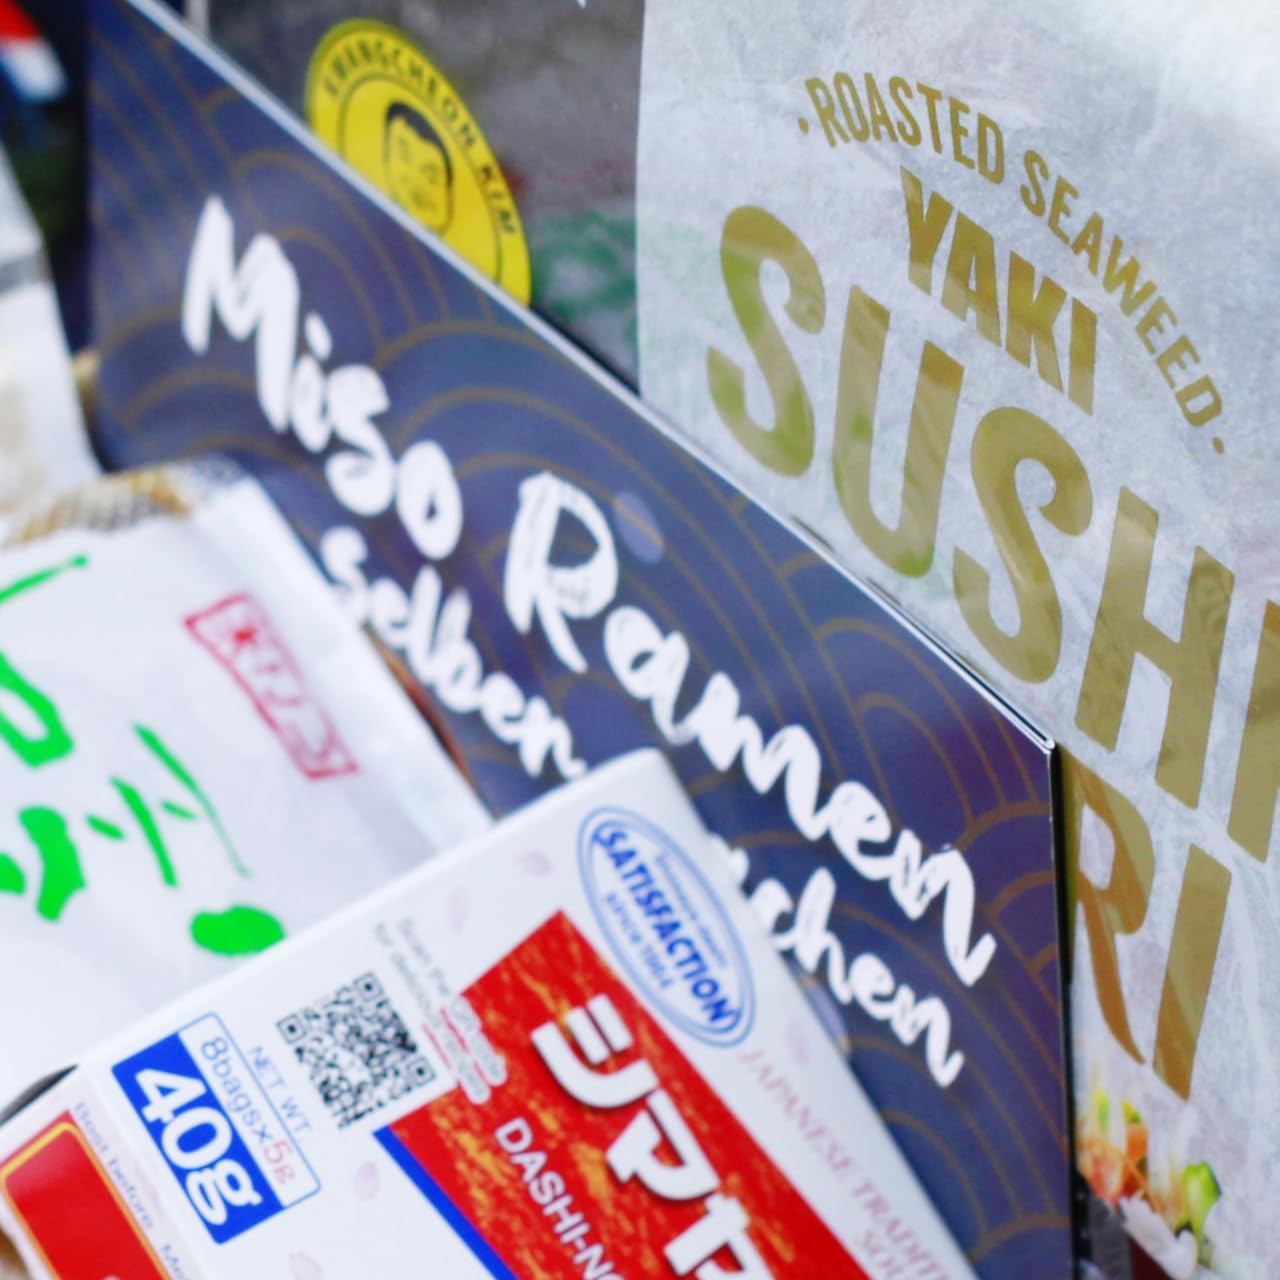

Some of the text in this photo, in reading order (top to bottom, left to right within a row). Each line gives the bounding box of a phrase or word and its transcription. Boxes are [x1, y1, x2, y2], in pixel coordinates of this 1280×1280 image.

[805, 71, 1223, 428] ROASTED SEAWEED
[900, 165, 1098, 416] YAKI
[182, 194, 463, 561] Miso
[504, 470, 998, 987] Ramen
[705, 204, 1280, 866] SUSHI
[594, 828, 734, 1024] SATISFACTION
[1061, 746, 1233, 1102] RI
[135, 1068, 264, 1227] 40g
